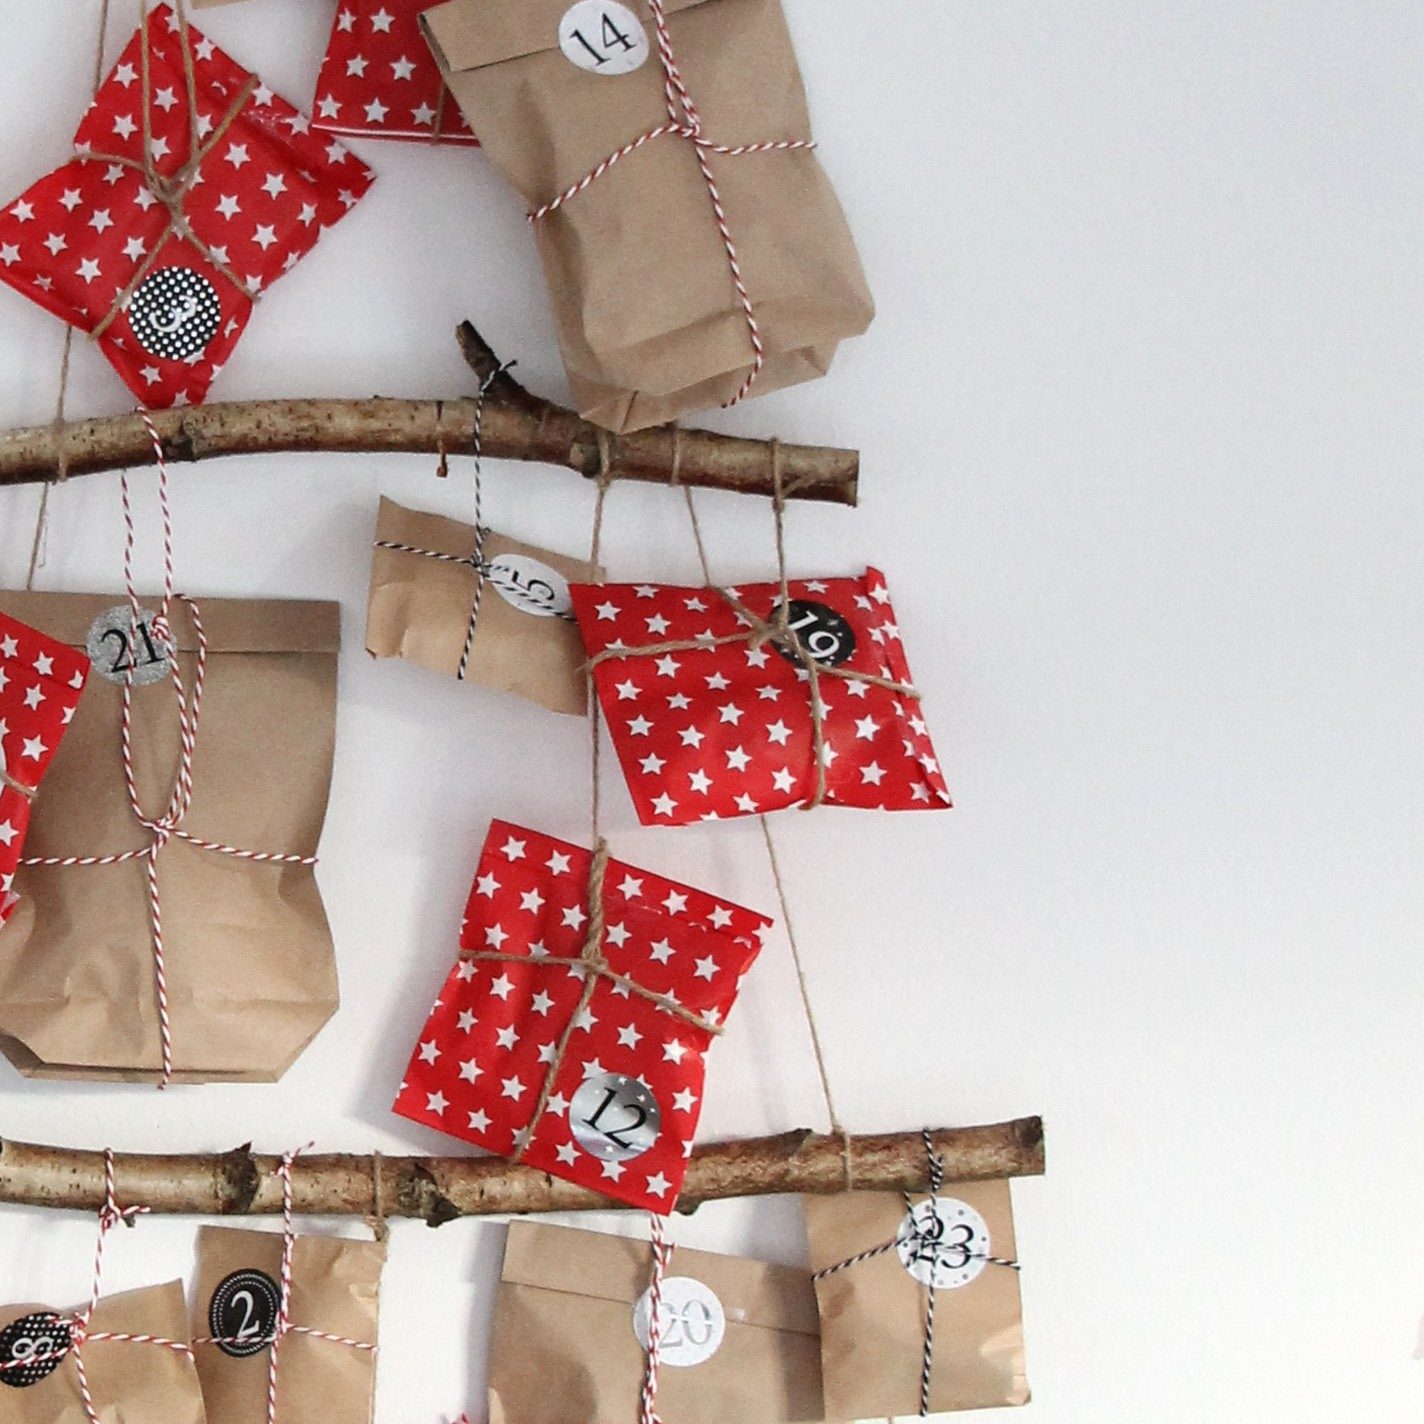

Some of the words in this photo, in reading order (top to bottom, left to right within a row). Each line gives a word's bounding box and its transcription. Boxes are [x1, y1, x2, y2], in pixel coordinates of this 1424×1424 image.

[569, 12, 636, 67] 14
[148, 295, 196, 333] 3
[511, 570, 555, 601] 5
[101, 620, 162, 671] 21
[788, 610, 841, 661] 19
[582, 1088, 649, 1149] 12
[910, 1215, 974, 1269] 23
[231, 1291, 260, 1337] 2
[657, 1298, 712, 1349] 20
[11, 1336, 55, 1360] 8
